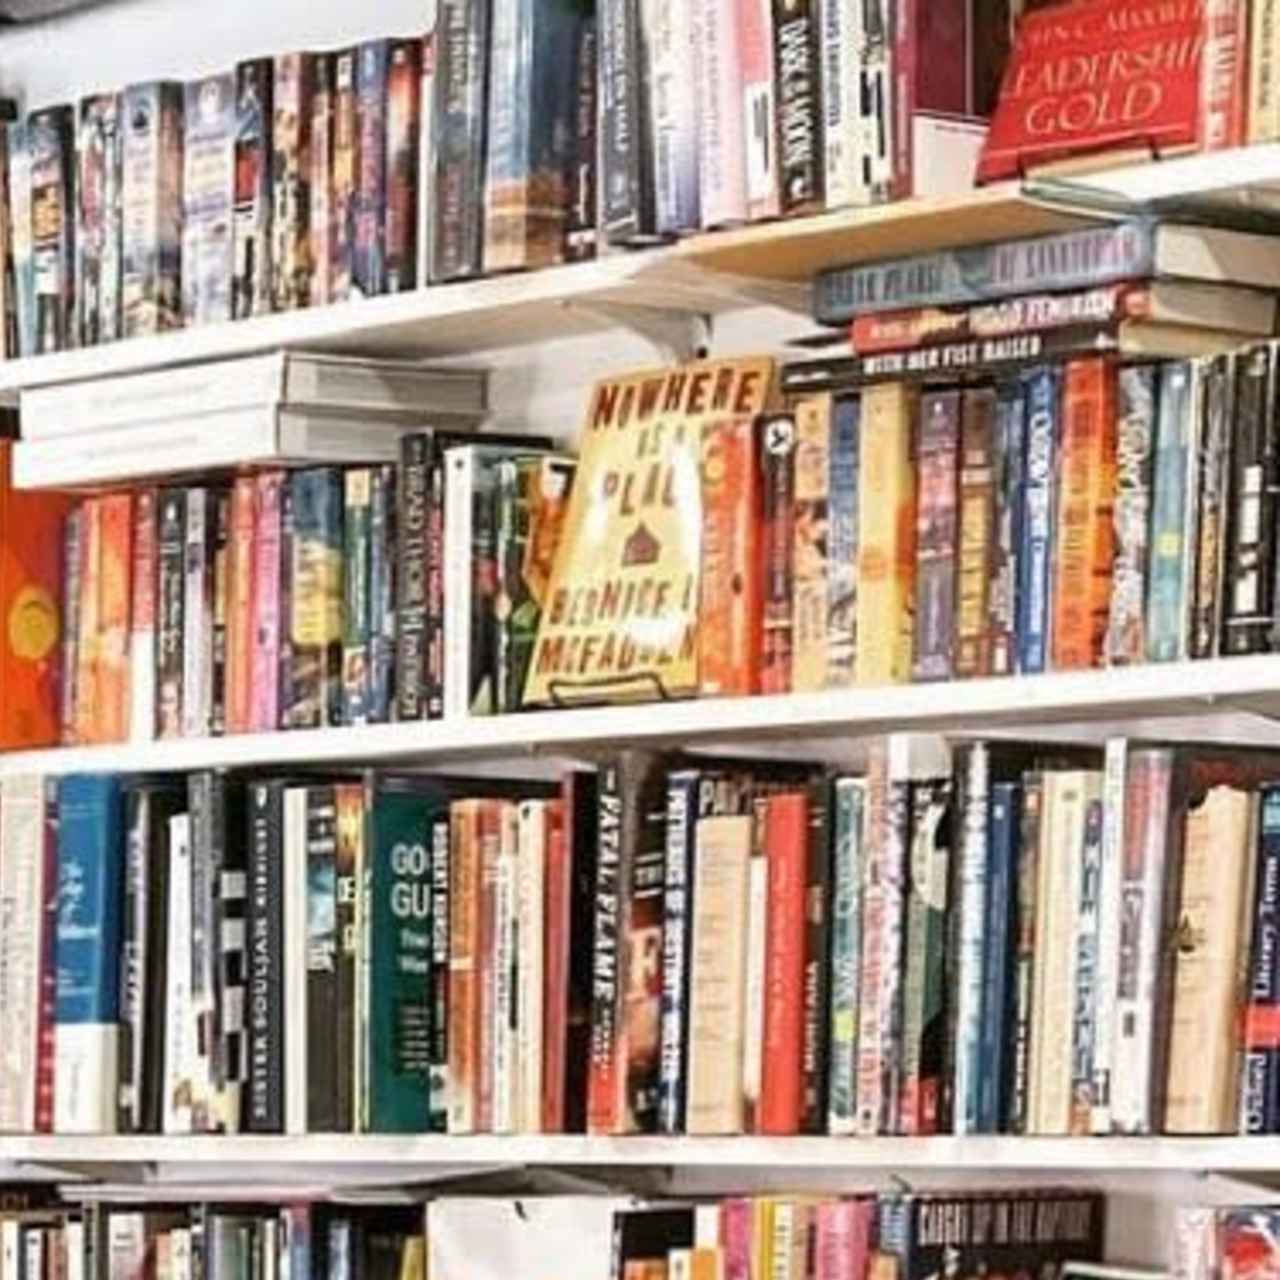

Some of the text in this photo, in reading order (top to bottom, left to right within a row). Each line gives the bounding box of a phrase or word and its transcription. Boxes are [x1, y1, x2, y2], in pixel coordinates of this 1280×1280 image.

[1008, 35, 1205, 98] EADERSHI
[1025, 80, 1163, 135] GOLD
[941, 342, 980, 367] FIST
[593, 368, 760, 430] NOWHERE
[391, 843, 430, 877] GO
[390, 881, 431, 918] GU
[592, 794, 623, 1001] FATAL FLAME
[1253, 856, 1278, 999] Literary Terms
[1247, 1053, 1266, 1131] Oxford
